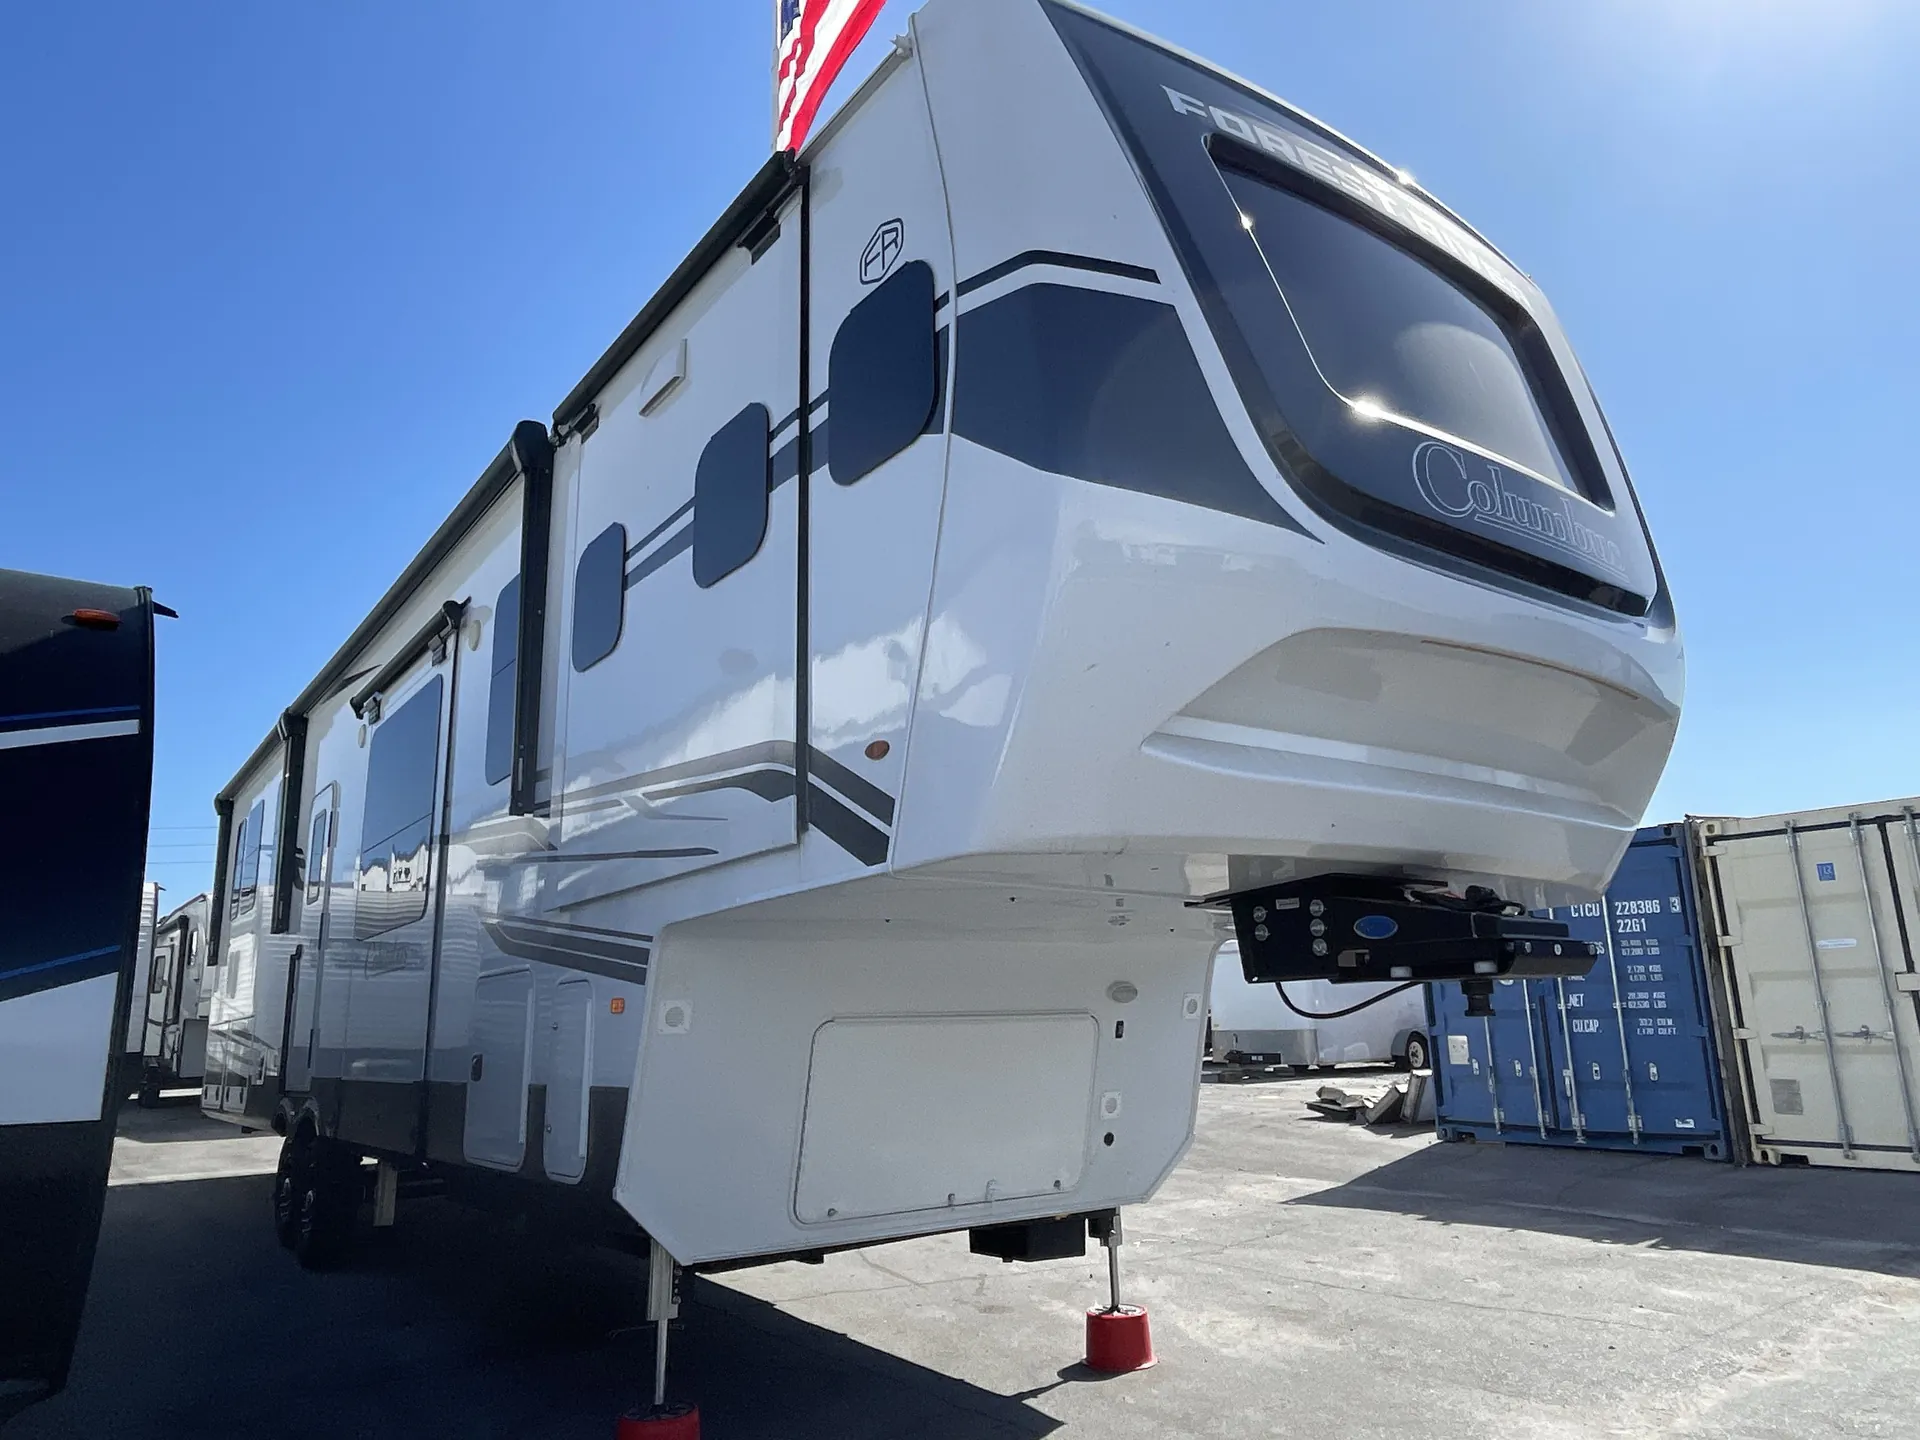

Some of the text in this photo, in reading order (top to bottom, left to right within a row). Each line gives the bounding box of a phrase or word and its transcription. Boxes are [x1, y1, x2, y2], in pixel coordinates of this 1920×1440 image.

[1160, 84, 1398, 217] FOREST
[1412, 441, 1627, 573] Columbus
[1615, 900, 1660, 916] 228386
[1669, 898, 1681, 913] 3
[1617, 918, 1647, 933] 22G1
[1569, 993, 1584, 1007] NET
